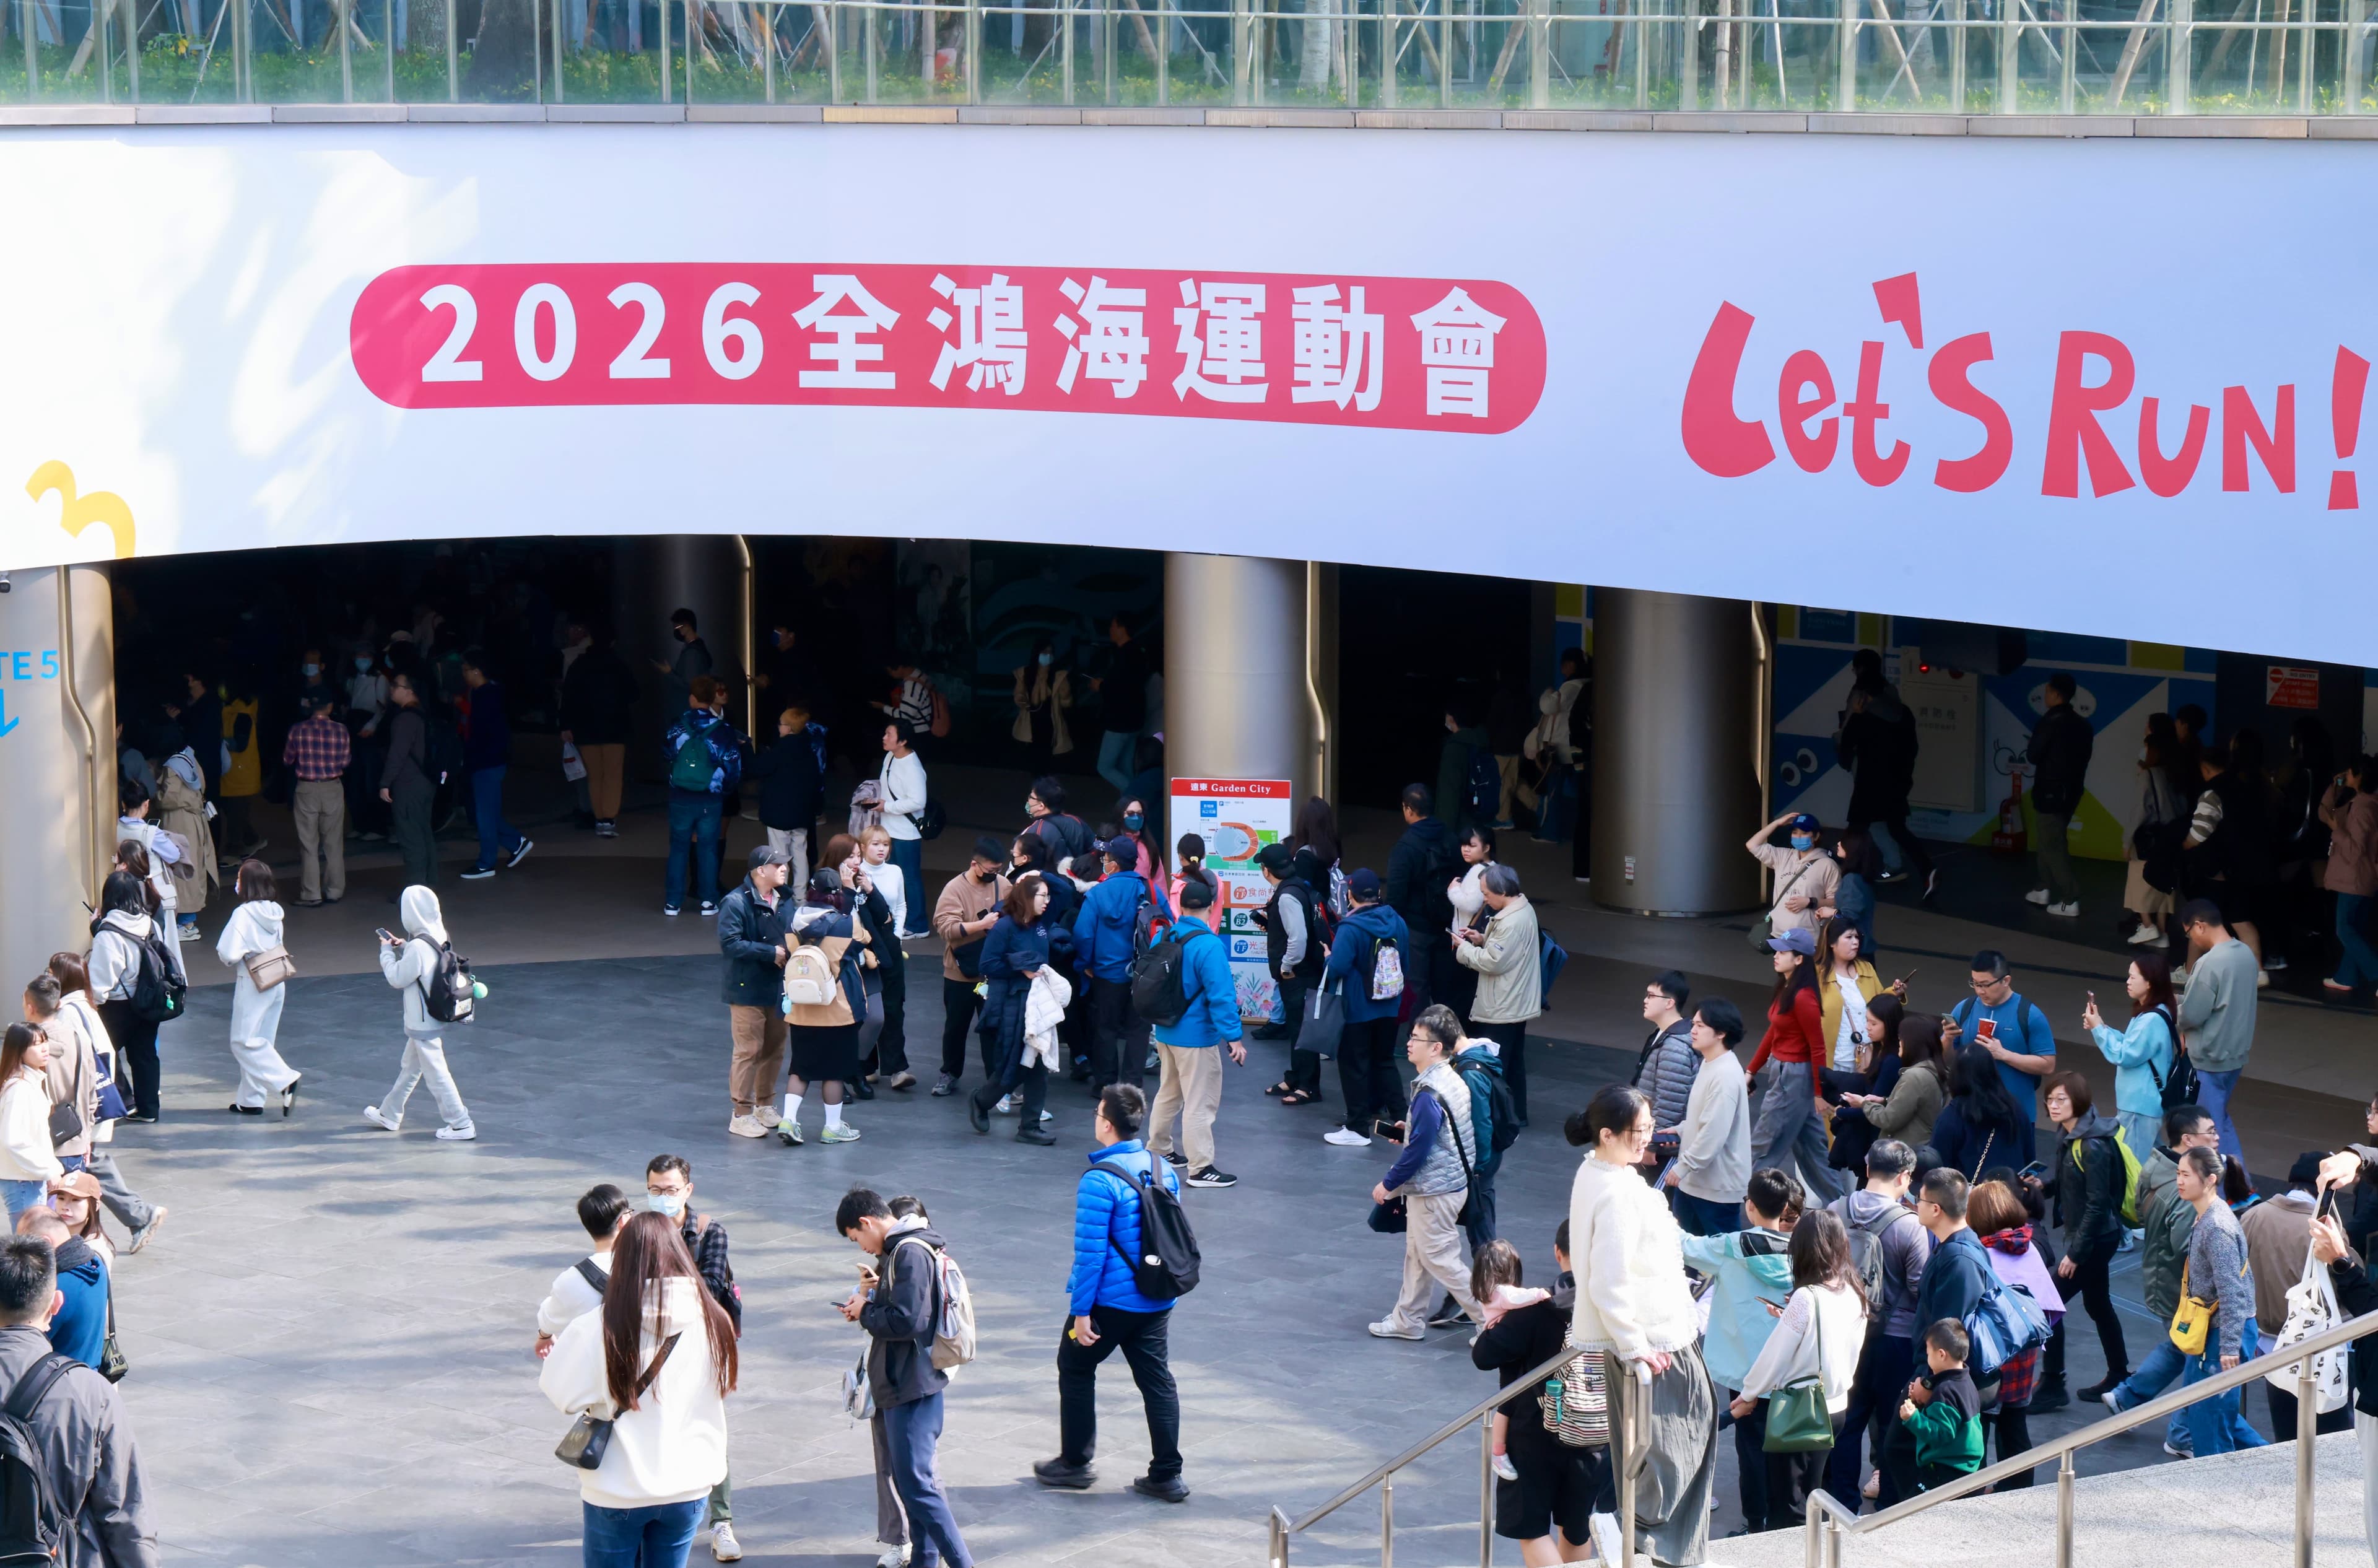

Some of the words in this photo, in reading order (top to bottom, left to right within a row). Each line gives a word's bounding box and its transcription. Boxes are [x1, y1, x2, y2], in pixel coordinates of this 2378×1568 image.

[419, 273, 1507, 419] 2026全鴻海運動會
[40, 650, 59, 679] 5
[1191, 783, 1208, 791] 遠東
[1211, 783, 1245, 792] Garden
[1250, 784, 1271, 795] City
